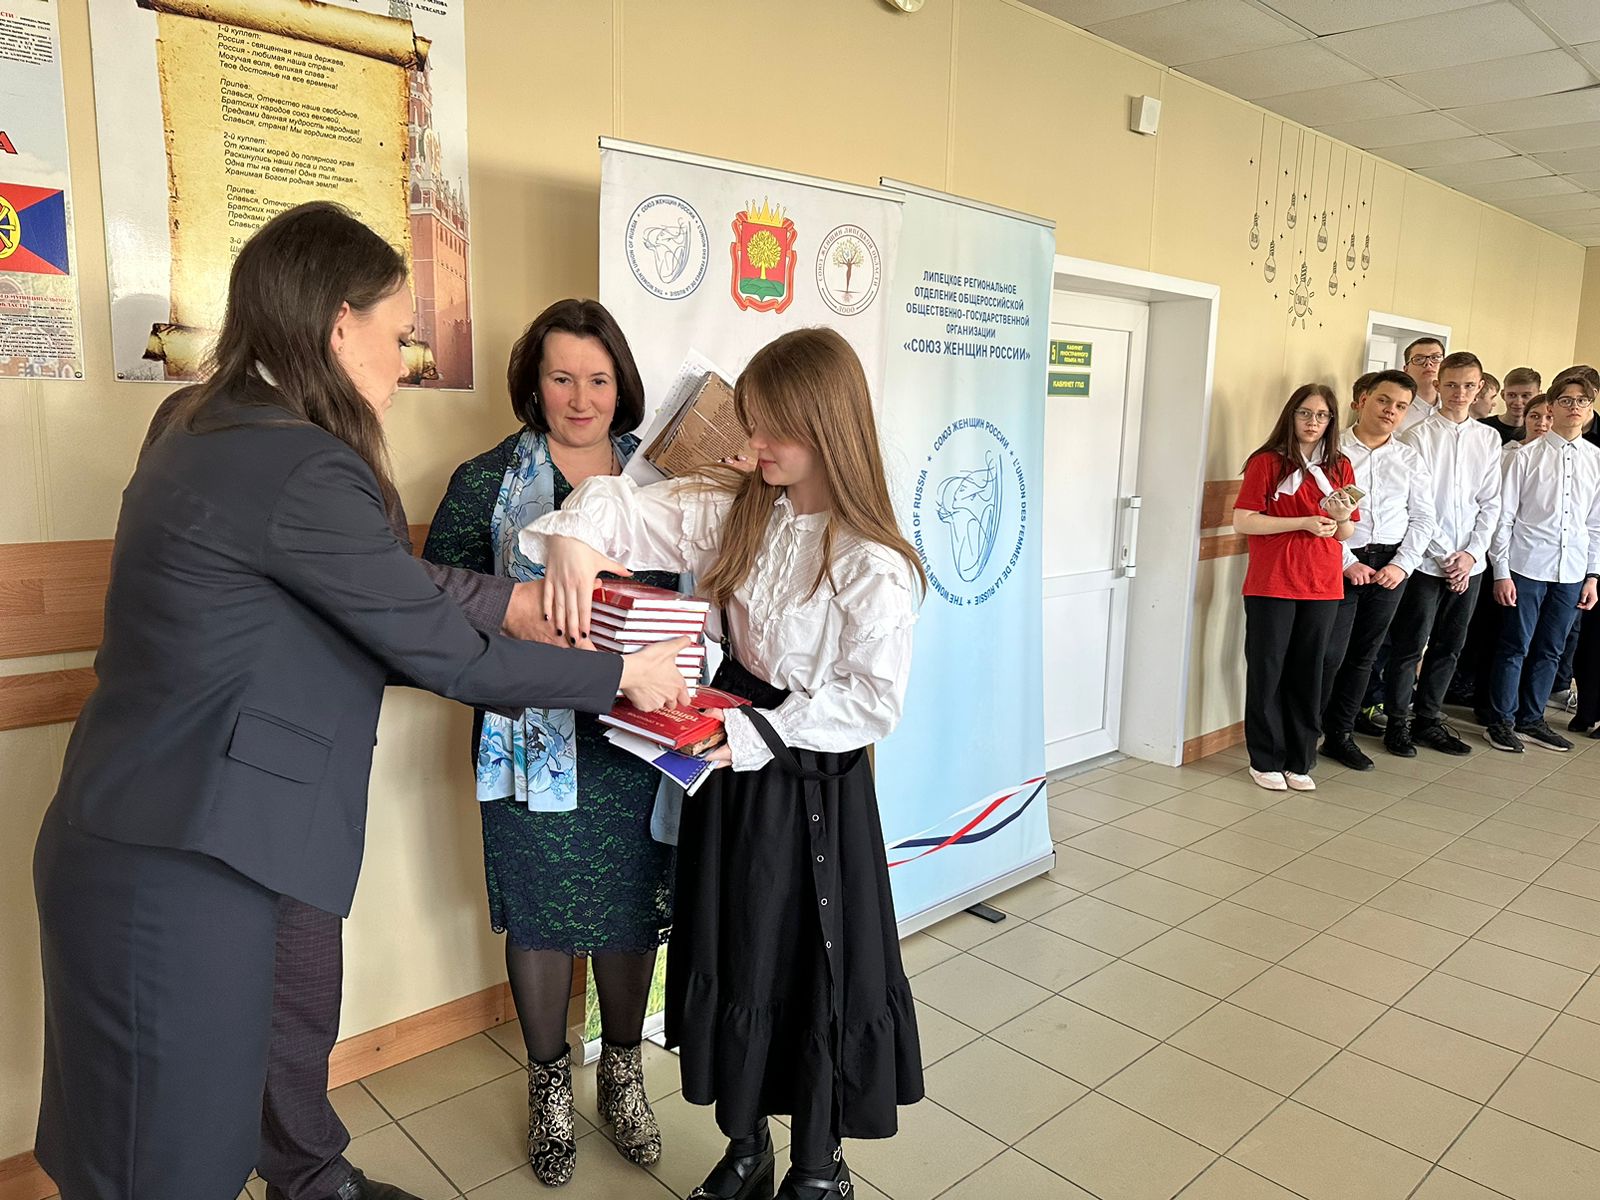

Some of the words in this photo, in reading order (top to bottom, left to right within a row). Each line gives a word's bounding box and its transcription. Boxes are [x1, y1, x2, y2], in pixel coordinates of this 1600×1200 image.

[218, 25, 229, 33] 1-й
[230, 28, 261, 39] куплет:
[217, 33, 245, 44] Россия
[251, 42, 292, 55] священная
[293, 51, 313, 60] наша
[314, 53, 346, 67] держава,
[217, 42, 245, 53] Россия
[251, 50, 285, 62] любимая
[286, 58, 306, 67] наша
[307, 62, 336, 73] страна.
[218, 52, 252, 65] Могучая
[252, 59, 272, 69] воля,
[273, 63, 303, 74] великая
[304, 70, 325, 79] слава
[219, 60, 237, 70] Твое
[239, 63, 280, 78] достоянье
[292, 76, 304, 84] все
[305, 78, 339, 90] времена!
[220, 78, 251, 90] Припев:
[220, 87, 254, 100] Славься,
[256, 94, 300, 108] Отечество
[301, 104, 321, 113] наше
[322, 105, 360, 120] свободное,
[221, 96, 258, 109] Братских
[260, 104, 291, 116] народов
[292, 110, 310, 119] союз
[221, 105, 259, 118] Предками
[261, 112, 287, 123] данная
[288, 118, 324, 130] мудрость
[325, 124, 360, 136] народная!
[222, 114, 256, 126] Славься,
[258, 121, 289, 132] страна!
[290, 125, 302, 134] Мы
[303, 129, 337, 141] гордимся
[337, 134, 363, 145] тобой!
[223, 131, 235, 140] 2-й
[237, 135, 267, 146] куплет:
[223, 140, 237, 149] От
[239, 144, 265, 154] южных
[266, 148, 290, 158] морей
[291, 151, 300, 159] до
[301, 154, 338, 165] полярного
[339, 159, 355, 168] края
[224, 149, 272, 163] Раскинулись
[273, 158, 293, 167] наши
[294, 161, 311, 169] леса
[319, 165, 337, 173] поля.
[224, 158, 245, 169] Одна
[246, 162, 260, 170] ты
[272, 166, 297, 175] свете!
[298, 169, 317, 178] Одна
[331, 175, 354, 183] такая
[225, 167, 263, 179] Хранимая
[264, 173, 288, 183] Богом
[289, 177, 315, 186] родная
[316, 180, 339, 189] земля!
[226, 184, 257, 195] Припев:
[227, 194, 260, 204] Славься,
[262, 198, 300, 208] Отечест
[227, 202, 264, 213] Братских
[228, 211, 265, 222] Предками
[641, 201, 655, 213] СОЮЗ
[677, 203, 696, 220] РОССИИ
[628, 219, 638, 239] RUSSIA
[628, 240, 634, 249] OF
[629, 249, 639, 269] UNION
[923, 270, 962, 287] ЛИПЕЦКОЕ
[964, 277, 1017, 295] РЕГИОНАЛЬНОЕ
[914, 286, 957, 303] ОТДЕЛЕНИЕ
[958, 293, 1024, 311] ОБЩЕРОССИЙСКОЙ
[906, 302, 1030, 327] ОБЩЕСТВЕННО-ГОСУДАРСТВЕННОЙ
[946, 323, 996, 339] ОРГАНИЗАЦИИ
[903, 338, 941, 354] «СОЮЗ
[943, 341, 988, 358] ЖЕНЩИН
[989, 345, 1031, 361] РОССИИ»
[933, 426, 952, 451] СОЮЗ
[952, 418, 985, 433] ЖЕНЩИН
[985, 421, 1010, 450] РОССИИ
[913, 469, 928, 509] RUSSIA
[1012, 458, 1026, 500] L'UNION
[913, 512, 920, 527] OF
[914, 530, 928, 565] UNION
[1009, 524, 1025, 566] FEMMES
[994, 577, 1003, 589] LA
[1002, 565, 1012, 580] DE
[949, 594, 963, 606] THE
[974, 586, 996, 605] RUSSIE
